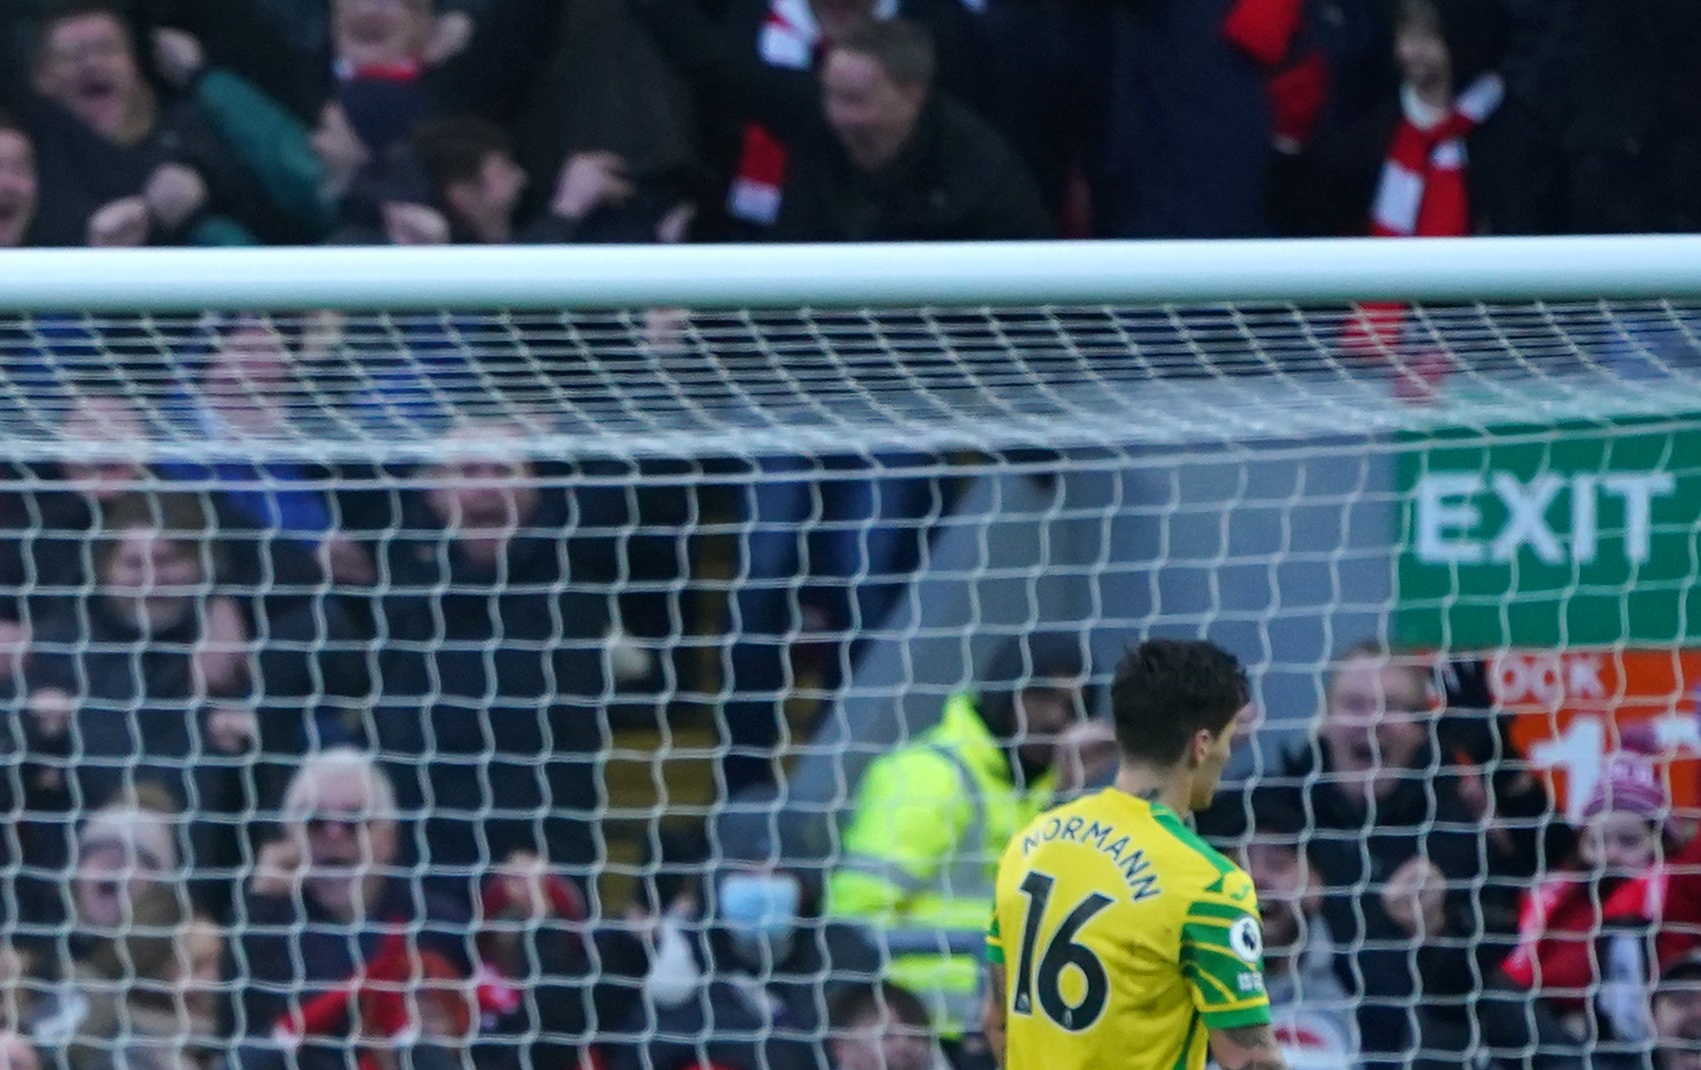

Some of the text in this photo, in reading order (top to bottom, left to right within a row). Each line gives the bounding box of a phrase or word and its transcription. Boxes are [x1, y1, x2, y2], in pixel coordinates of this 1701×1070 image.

[1416, 470, 1677, 564] EXIT
[1022, 815, 1162, 903] NORMANN
[1013, 869, 1117, 1034] 16
